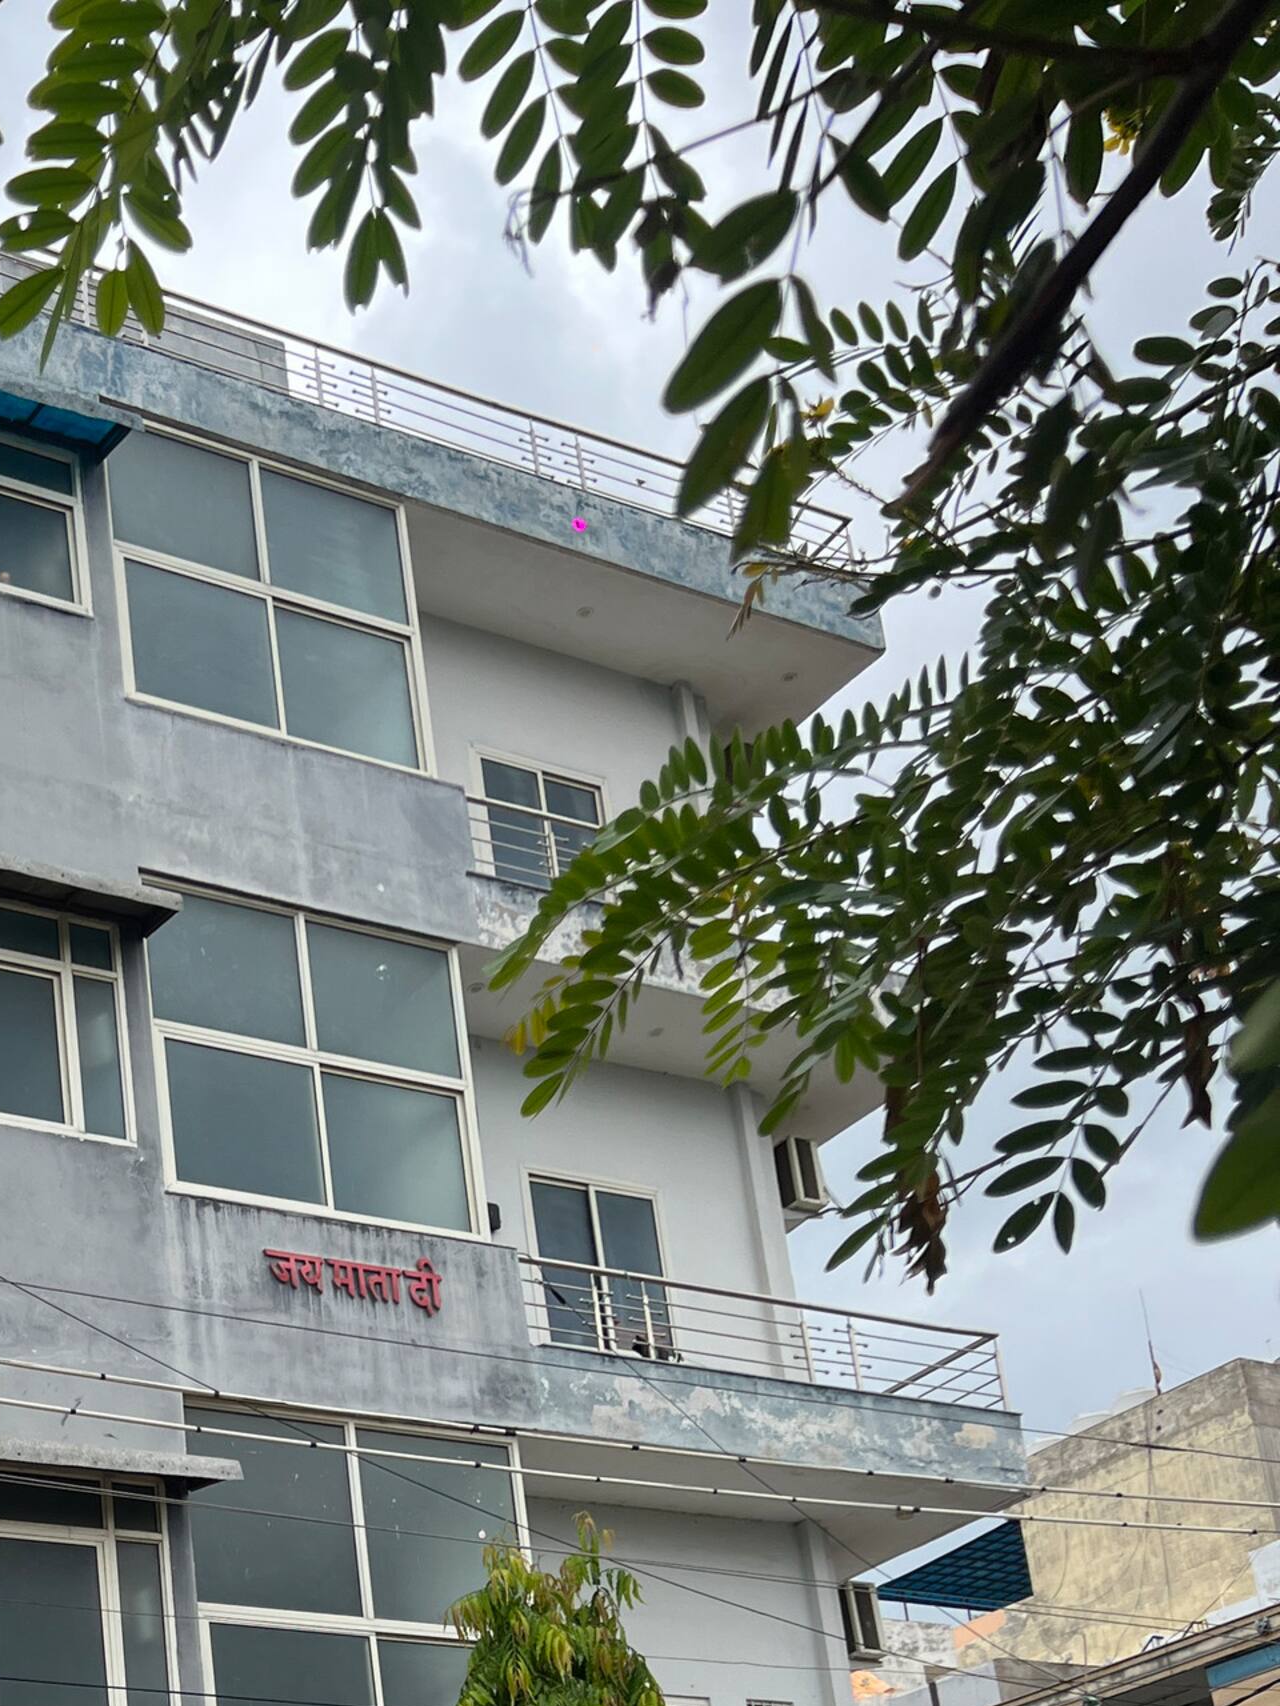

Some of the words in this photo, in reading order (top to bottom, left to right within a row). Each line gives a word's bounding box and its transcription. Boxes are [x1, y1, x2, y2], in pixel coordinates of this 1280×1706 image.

[263, 1248, 324, 1294] जय
[324, 1258, 402, 1304] माता
[402, 1256, 443, 1317] दी
